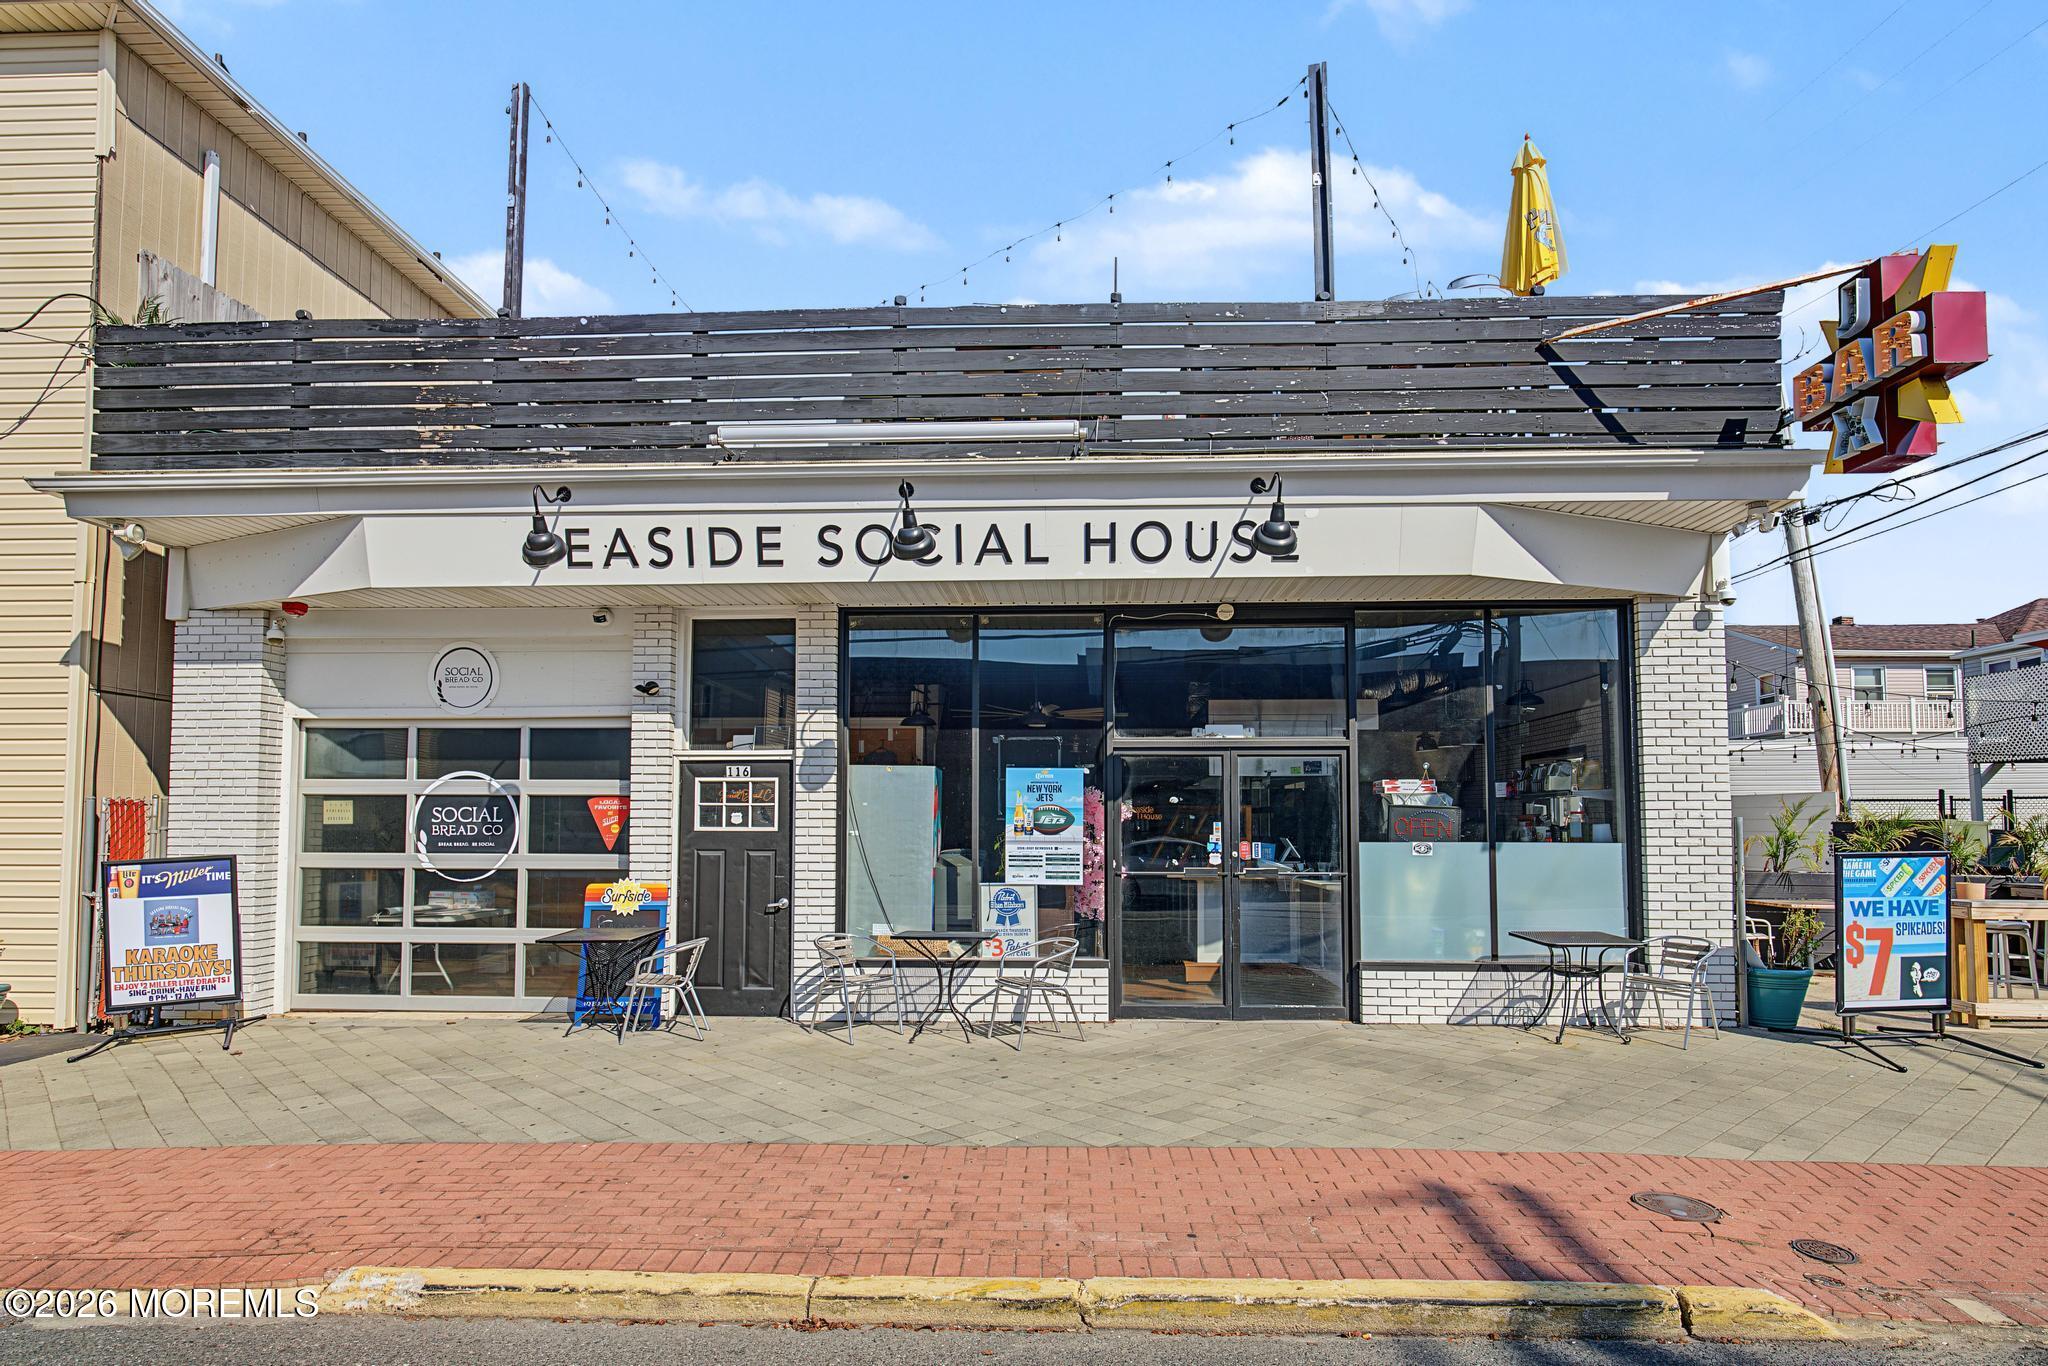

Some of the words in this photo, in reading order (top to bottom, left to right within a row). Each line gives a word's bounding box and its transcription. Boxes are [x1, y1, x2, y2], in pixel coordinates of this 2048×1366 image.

[1793, 310, 1928, 422] BAR
[565, 526, 784, 570] EASIDE
[445, 667, 483, 676] SOCIAL
[728, 766, 749, 776] 116
[1027, 784, 1042, 793] NEW
[1044, 784, 1062, 793] YORK
[1036, 794, 1054, 802] JETS
[432, 806, 504, 822] SOCIAL
[1035, 813, 1067, 824] JETS
[432, 824, 478, 836] BREAD
[482, 824, 504, 836] CO
[1394, 816, 1454, 838] OPEN
[142, 874, 160, 884] IT'S
[158, 866, 214, 890] Miller
[206, 872, 232, 881] TIME
[602, 888, 652, 904] Surfside
[1850, 900, 1884, 917] WE
[1888, 899, 1940, 916] HAVE
[1896, 921, 1946, 936] SPIKEADES!
[126, 944, 219, 966] KARAOKE
[985, 938, 1004, 957] $3
[1846, 920, 1894, 996] $7
[112, 959, 232, 984] THURSDAYS!
[114, 983, 138, 992] ENJOY
[150, 980, 178, 989] MILLER
[201, 984, 216, 992] FUN
